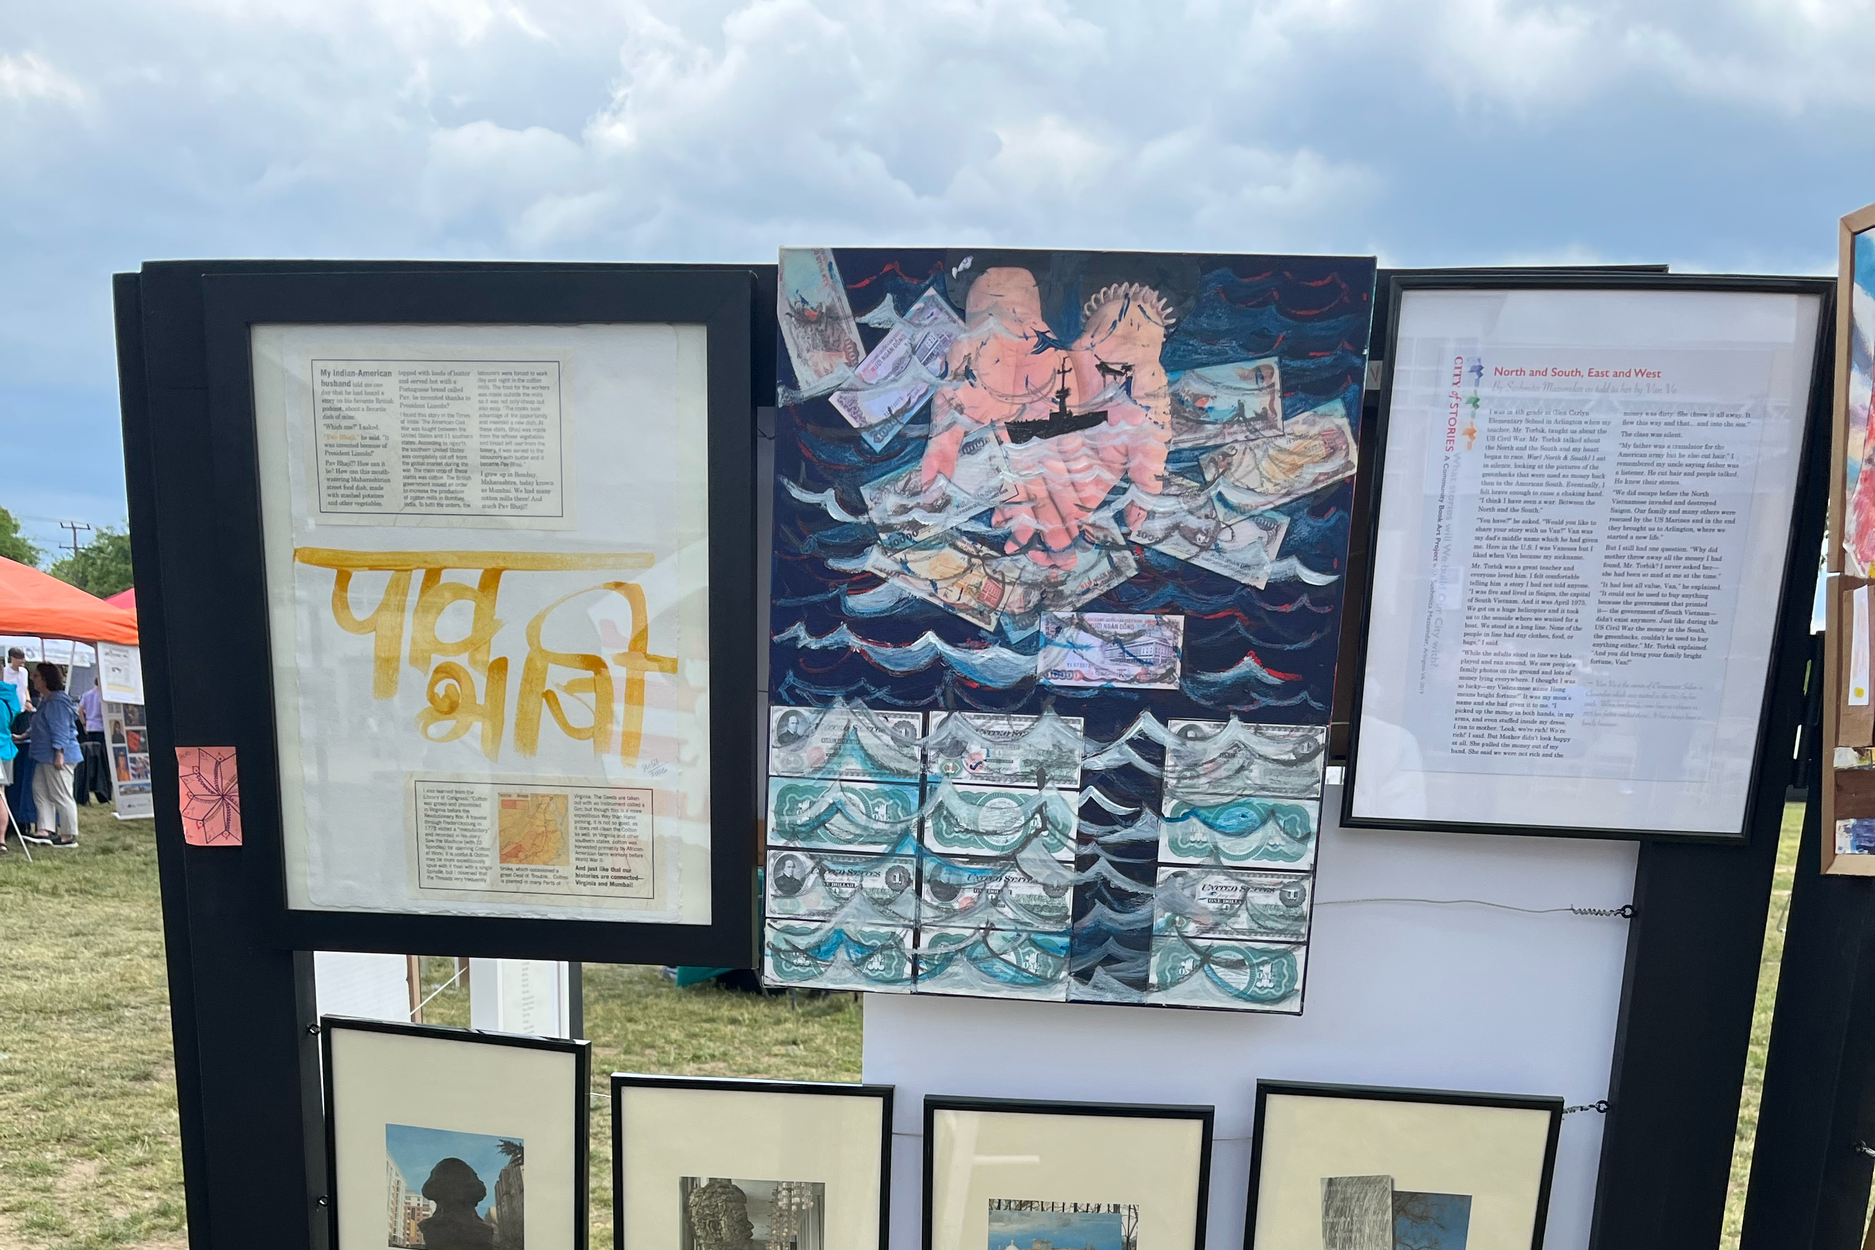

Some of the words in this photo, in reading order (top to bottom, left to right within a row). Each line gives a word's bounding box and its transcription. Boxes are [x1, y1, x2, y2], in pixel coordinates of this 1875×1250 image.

[320, 369, 331, 378] My
[1452, 356, 1463, 388] CITY
[1494, 367, 1526, 376] North
[1551, 368, 1584, 377] South,
[1588, 368, 1610, 377] East
[1634, 370, 1661, 378] West
[1449, 391, 1462, 401] of
[1646, 383, 1662, 394] Van
[1445, 403, 1459, 452] STORIES
[1449, 453, 1462, 482] What
[1439, 463, 1449, 503] Community
[1445, 486, 1457, 520] stories
[1433, 537, 1441, 560] Project
[1432, 618, 1444, 638] City
[1202, 884, 1237, 892] UNITED
